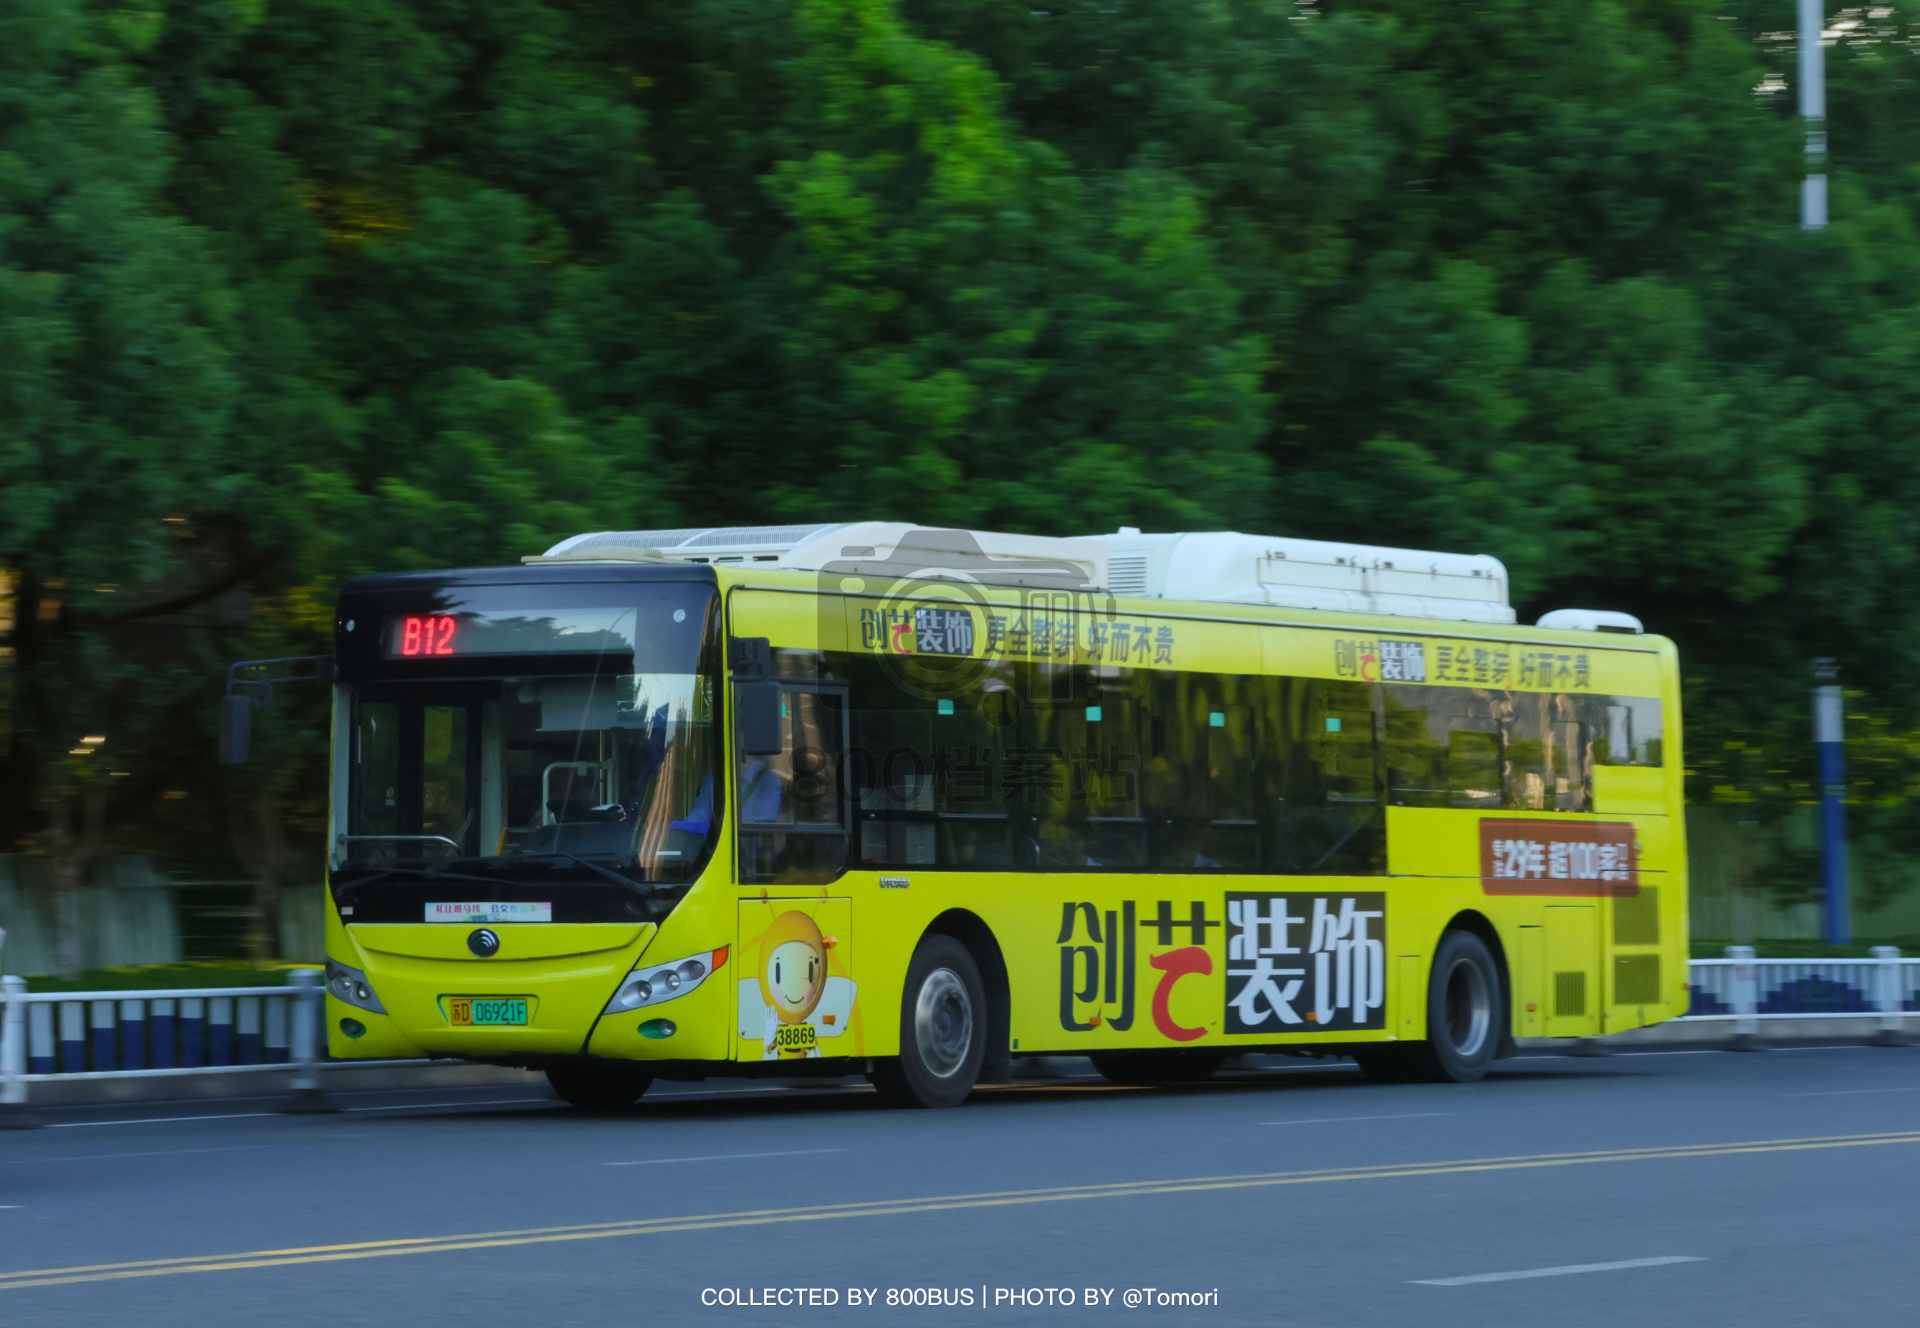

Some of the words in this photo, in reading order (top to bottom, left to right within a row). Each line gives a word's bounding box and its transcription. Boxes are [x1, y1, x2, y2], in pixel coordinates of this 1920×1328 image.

[403, 616, 455, 656] B12
[861, 607, 974, 656] 创艺装饰
[985, 615, 1077, 659] 更全整装
[1087, 620, 1175, 665] 好而不贵
[1334, 639, 1426, 682] 创艺装饰
[1436, 646, 1510, 684] 更全整装
[1518, 652, 1590, 688] 好而不贵
[1056, 898, 1385, 1042] 创艺装饰
[777, 1027, 816, 1046] 38869
